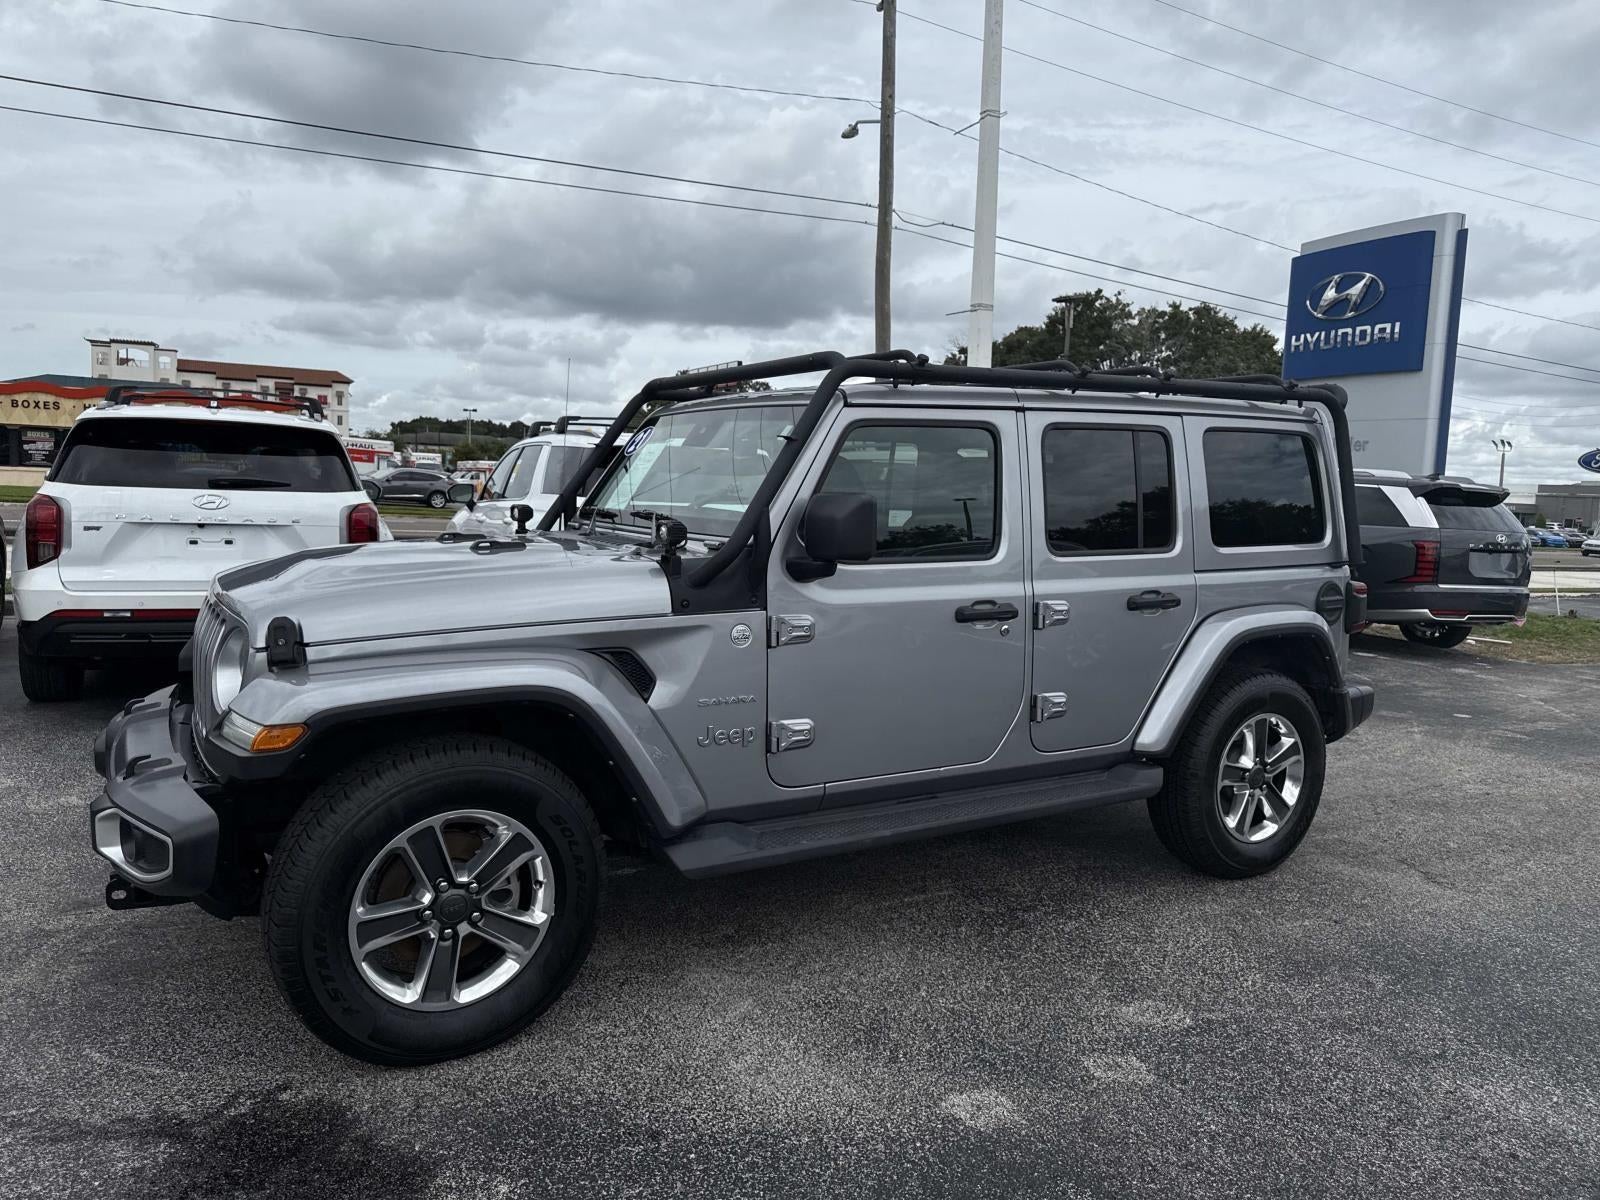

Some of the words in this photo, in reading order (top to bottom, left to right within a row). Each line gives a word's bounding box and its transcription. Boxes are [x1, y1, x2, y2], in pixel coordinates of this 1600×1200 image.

[1291, 321, 1401, 353] HYUNDAI
[10, 399, 61, 410] BOXES
[1350, 436, 1369, 452] er
[697, 695, 757, 707] SAHARA
[697, 725, 755, 748] Jeep
